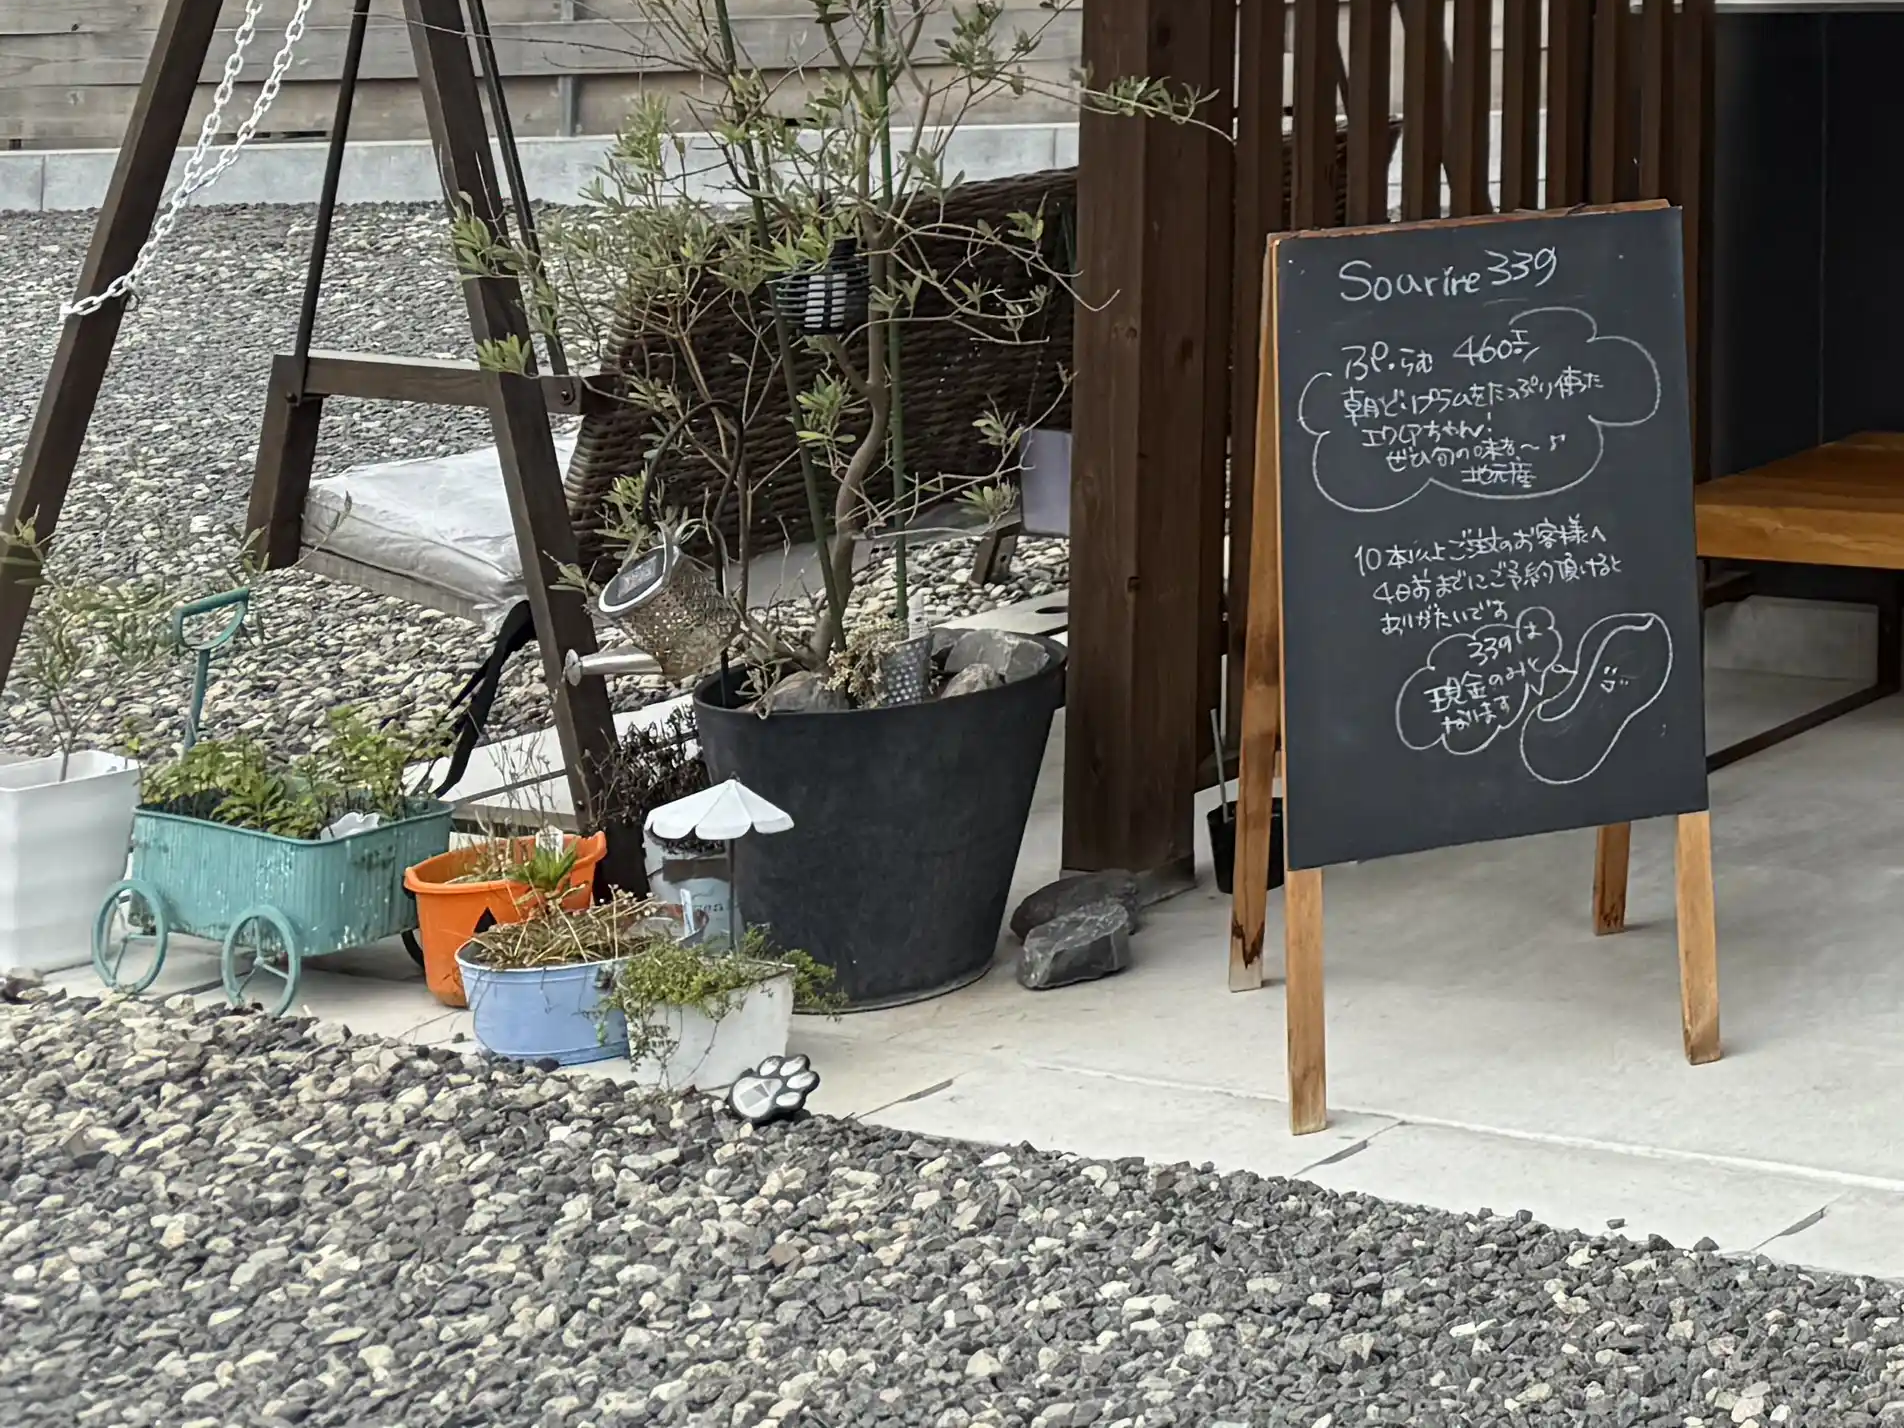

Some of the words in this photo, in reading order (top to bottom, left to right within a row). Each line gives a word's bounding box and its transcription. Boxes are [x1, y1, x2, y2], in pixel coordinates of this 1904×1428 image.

[1484, 246, 1557, 287] 339
[1380, 599, 1508, 636] ありがたいです
[1441, 695, 1510, 734] なります
